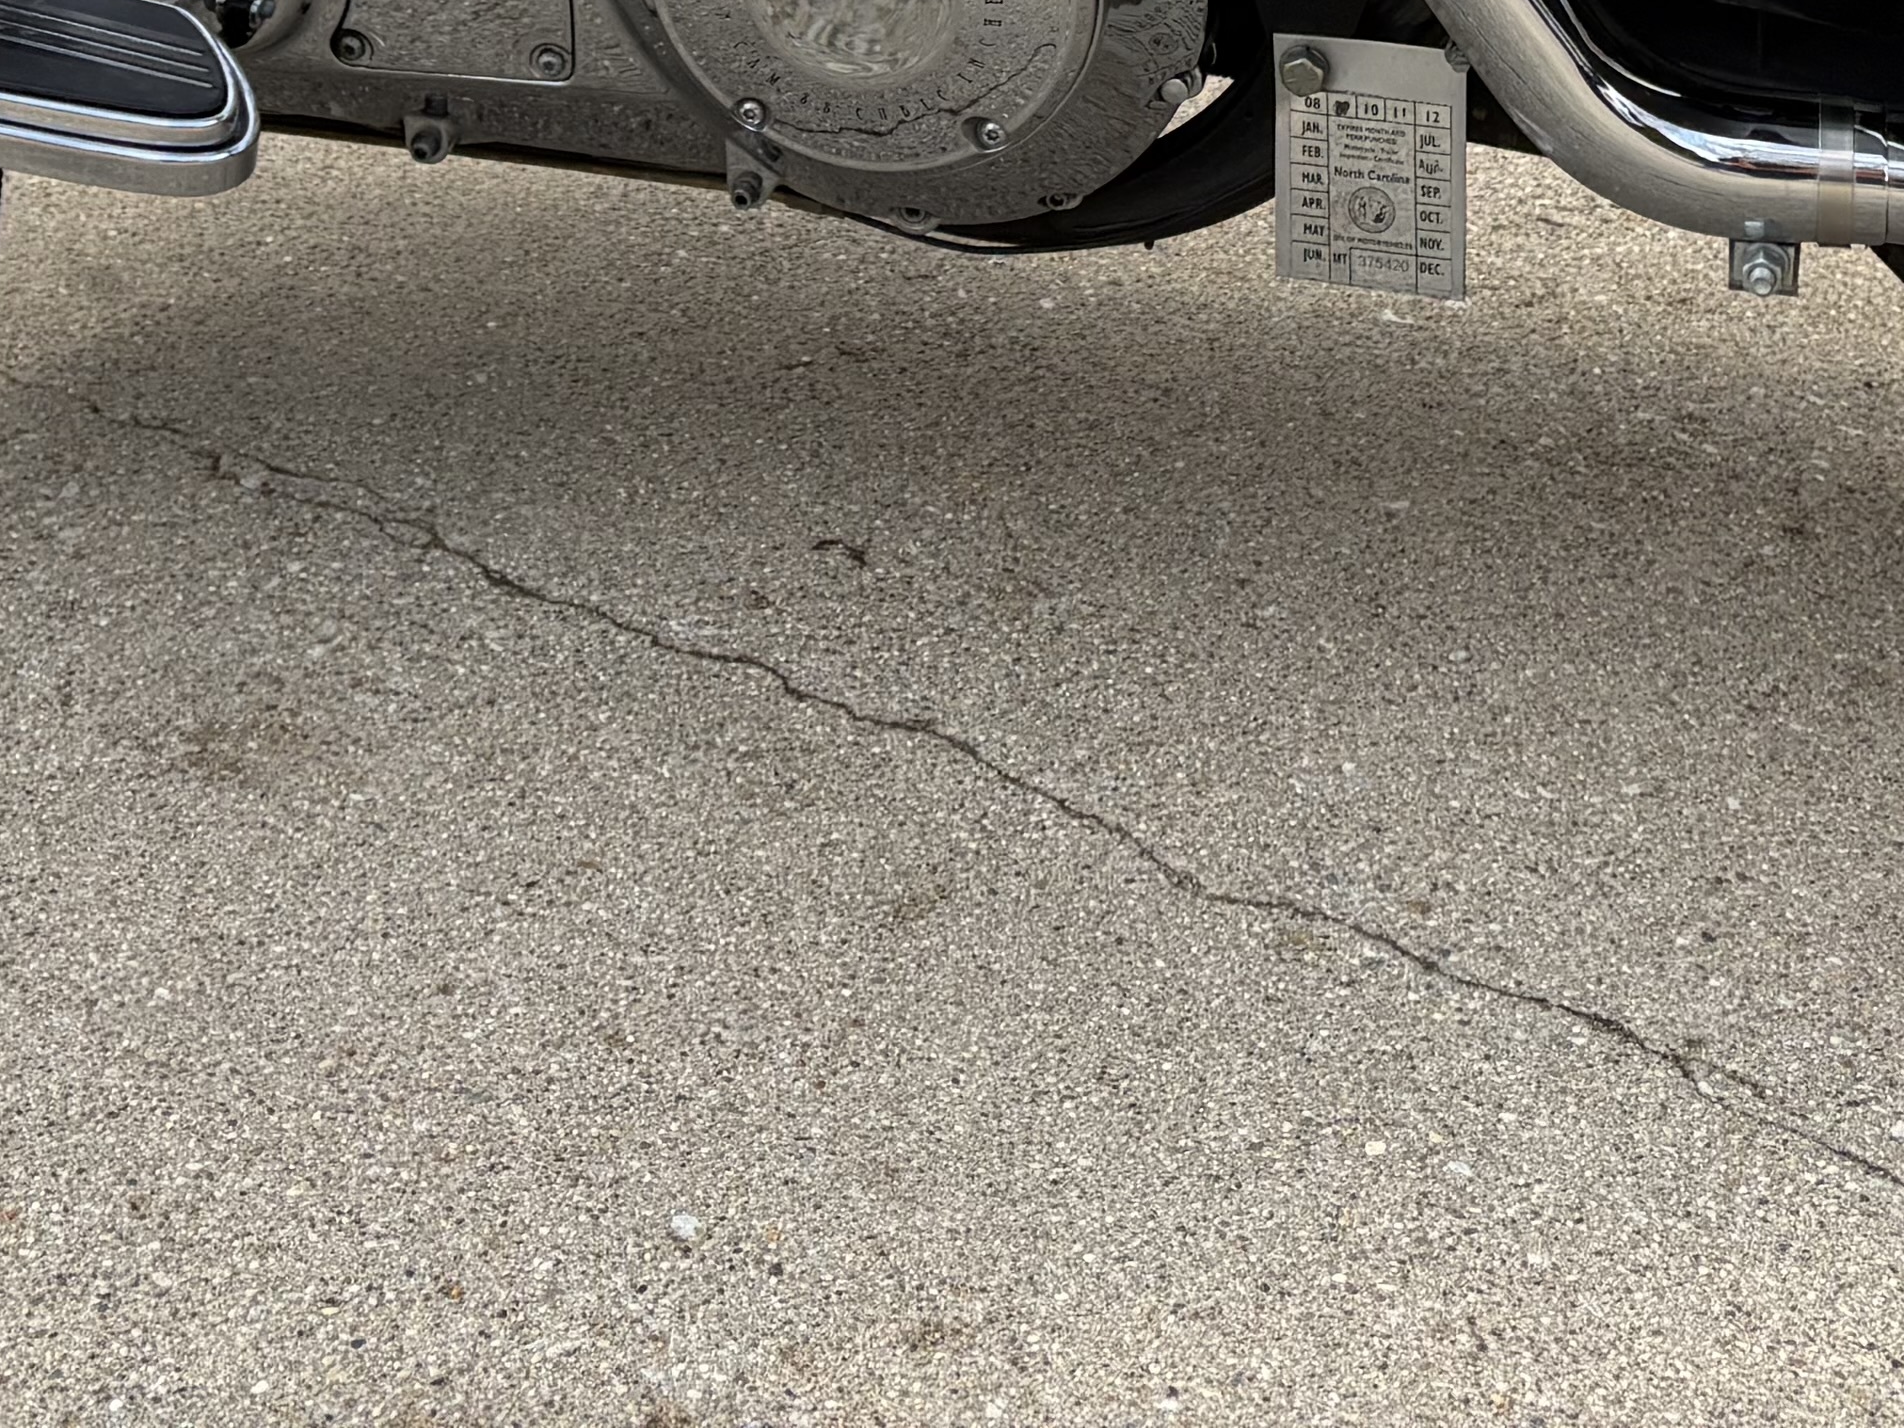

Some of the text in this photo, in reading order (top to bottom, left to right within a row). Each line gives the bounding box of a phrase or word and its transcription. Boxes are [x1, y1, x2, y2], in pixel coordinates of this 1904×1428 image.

[1304, 96, 1321, 110] 08
[1364, 103, 1379, 116] 10
[1393, 106, 1407, 119] 11
[1425, 110, 1441, 123] 12
[1301, 144, 1324, 160] FEB.
[1334, 165, 1411, 185] North Carolina
[1302, 222, 1326, 238] MAY
[1419, 261, 1445, 277] DEC.
